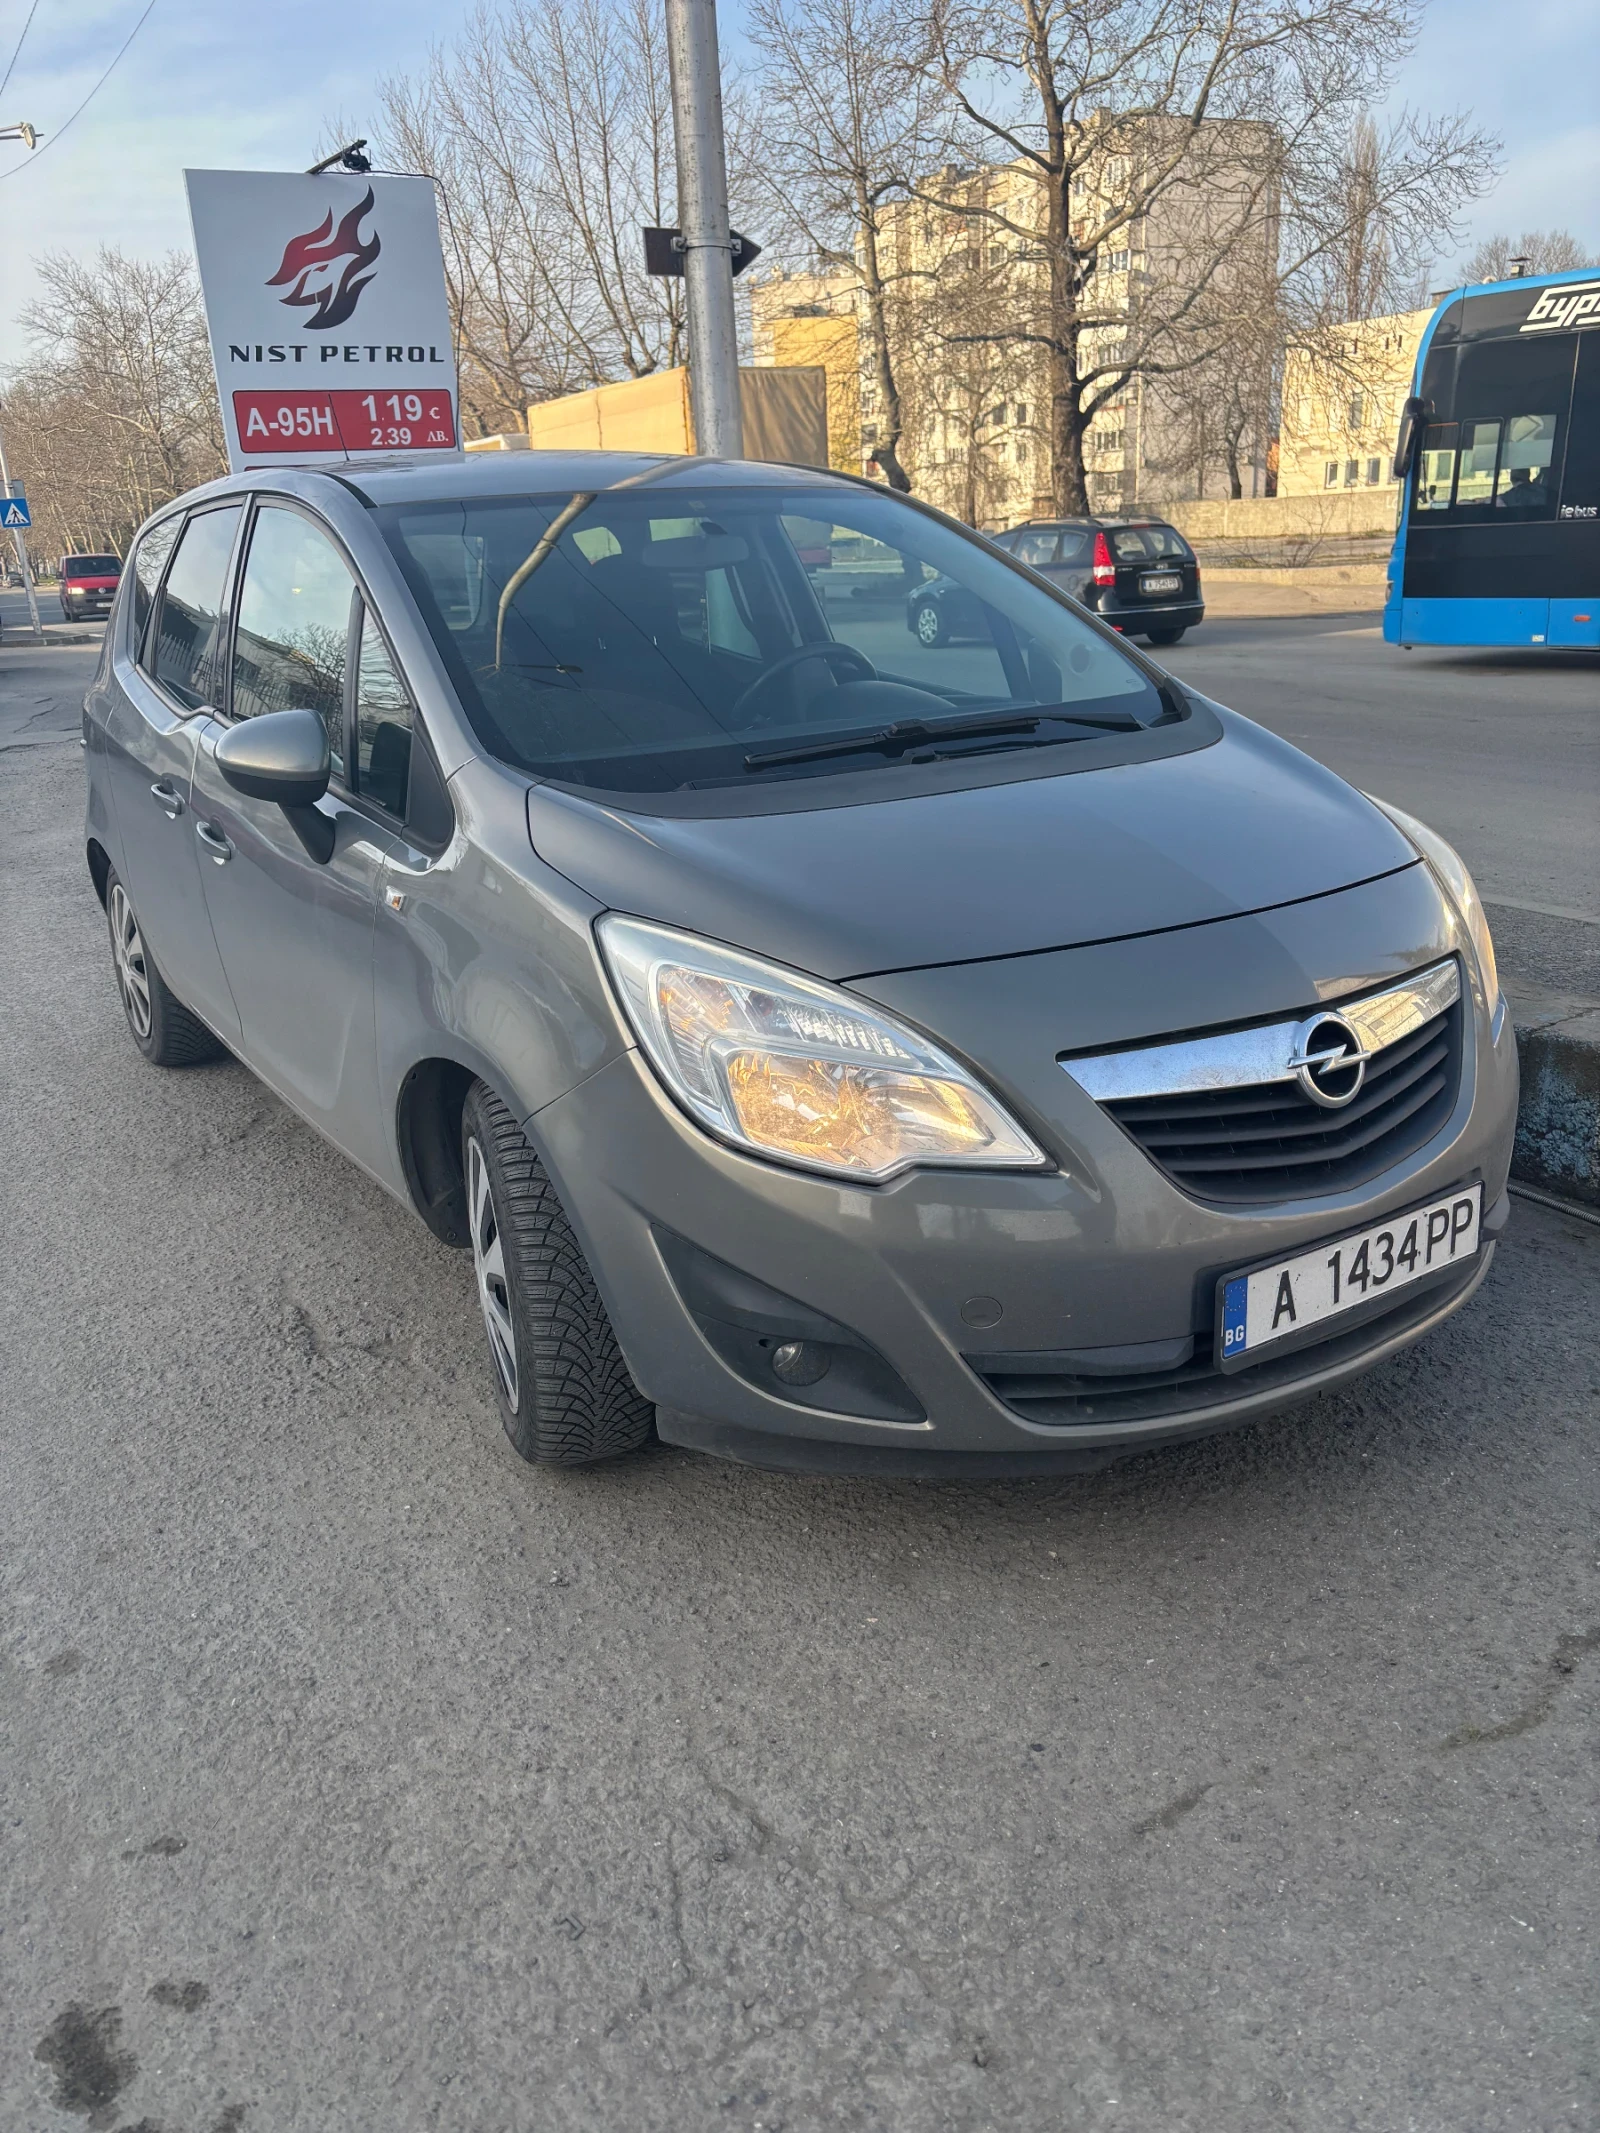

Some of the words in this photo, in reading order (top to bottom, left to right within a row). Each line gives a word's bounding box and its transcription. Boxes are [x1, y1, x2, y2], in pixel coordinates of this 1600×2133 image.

[228, 345, 308, 363] NIST
[319, 345, 446, 363] PETROL
[361, 394, 423, 422] 1.19
[428, 406, 441, 420] €
[370, 427, 412, 446] 2.39
[1271, 1269, 1297, 1330] A
[1327, 1198, 1474, 1305] 1434PP
[1224, 1324, 1245, 1347] BG
